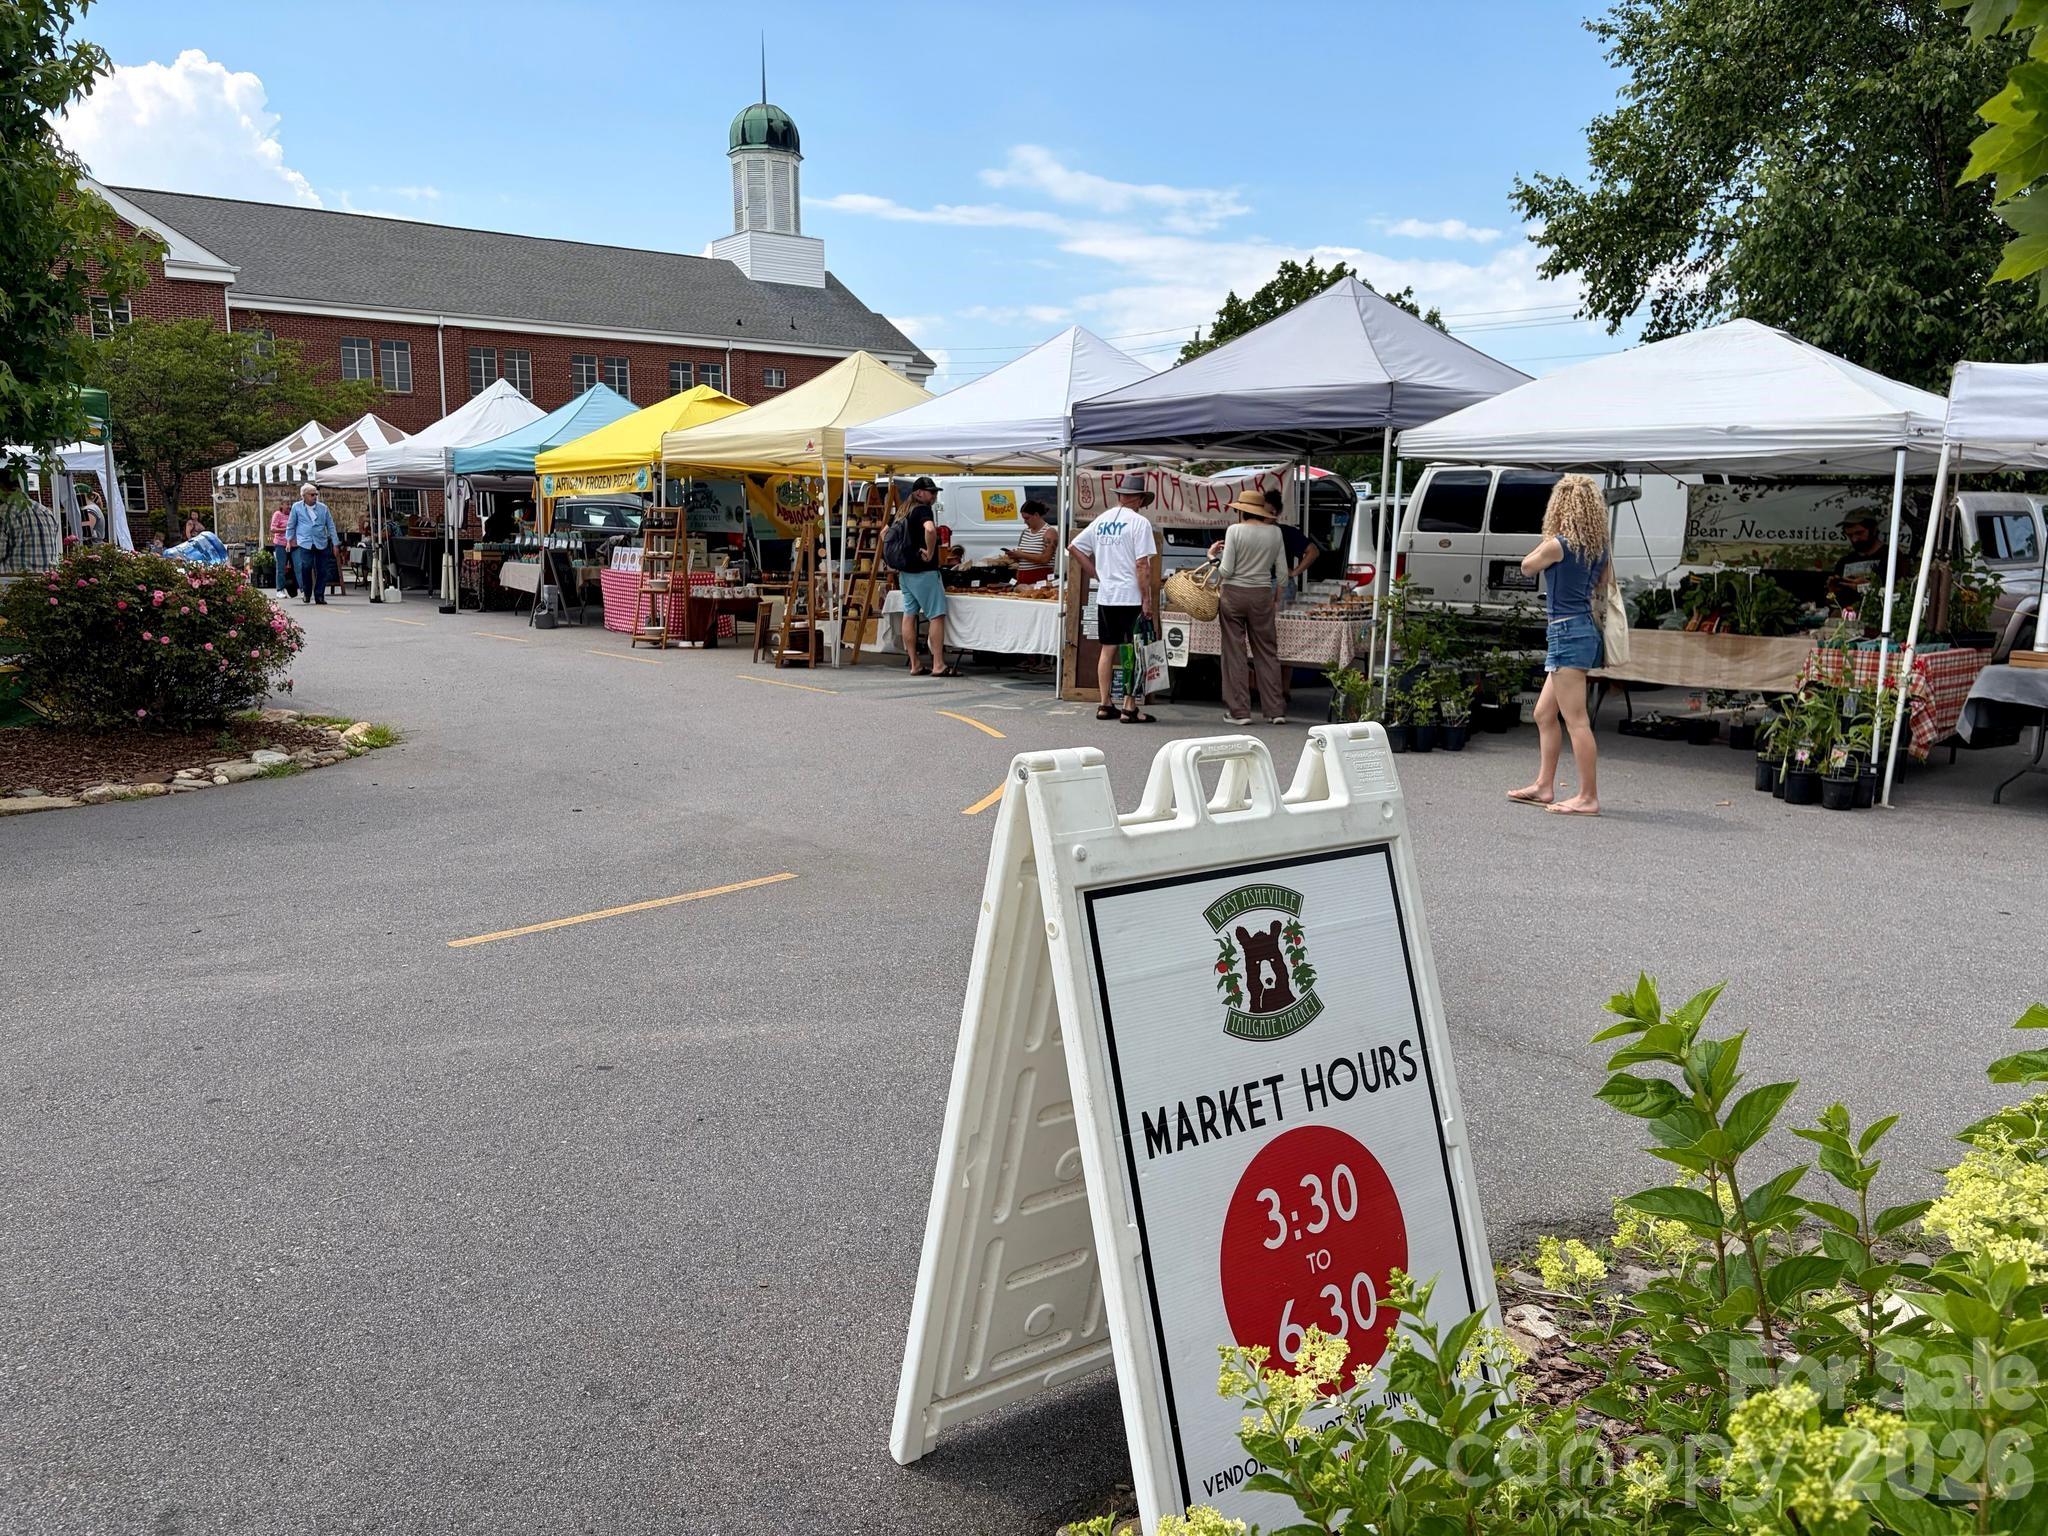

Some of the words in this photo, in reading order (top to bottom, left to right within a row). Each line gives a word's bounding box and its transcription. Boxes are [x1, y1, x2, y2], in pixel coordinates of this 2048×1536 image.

[556, 476, 584, 491] ARTISAN
[585, 474, 611, 490] FROZEN
[1101, 470, 1184, 511] FRNCH
[1097, 521, 1129, 535] SKYY
[1688, 519, 1728, 538] Bear
[1733, 519, 1847, 540] Necessities
[1211, 895, 1241, 923] WEST
[1242, 888, 1297, 911] ASHEVILLE
[1230, 1014, 1279, 1036] TAILGATE
[1279, 997, 1318, 1032] MARKET
[1141, 1074, 1285, 1160] MARKET
[1301, 1039, 1418, 1112] HOURS
[1256, 1163, 1359, 1250] 3:30
[1306, 1249, 1332, 1275] TO
